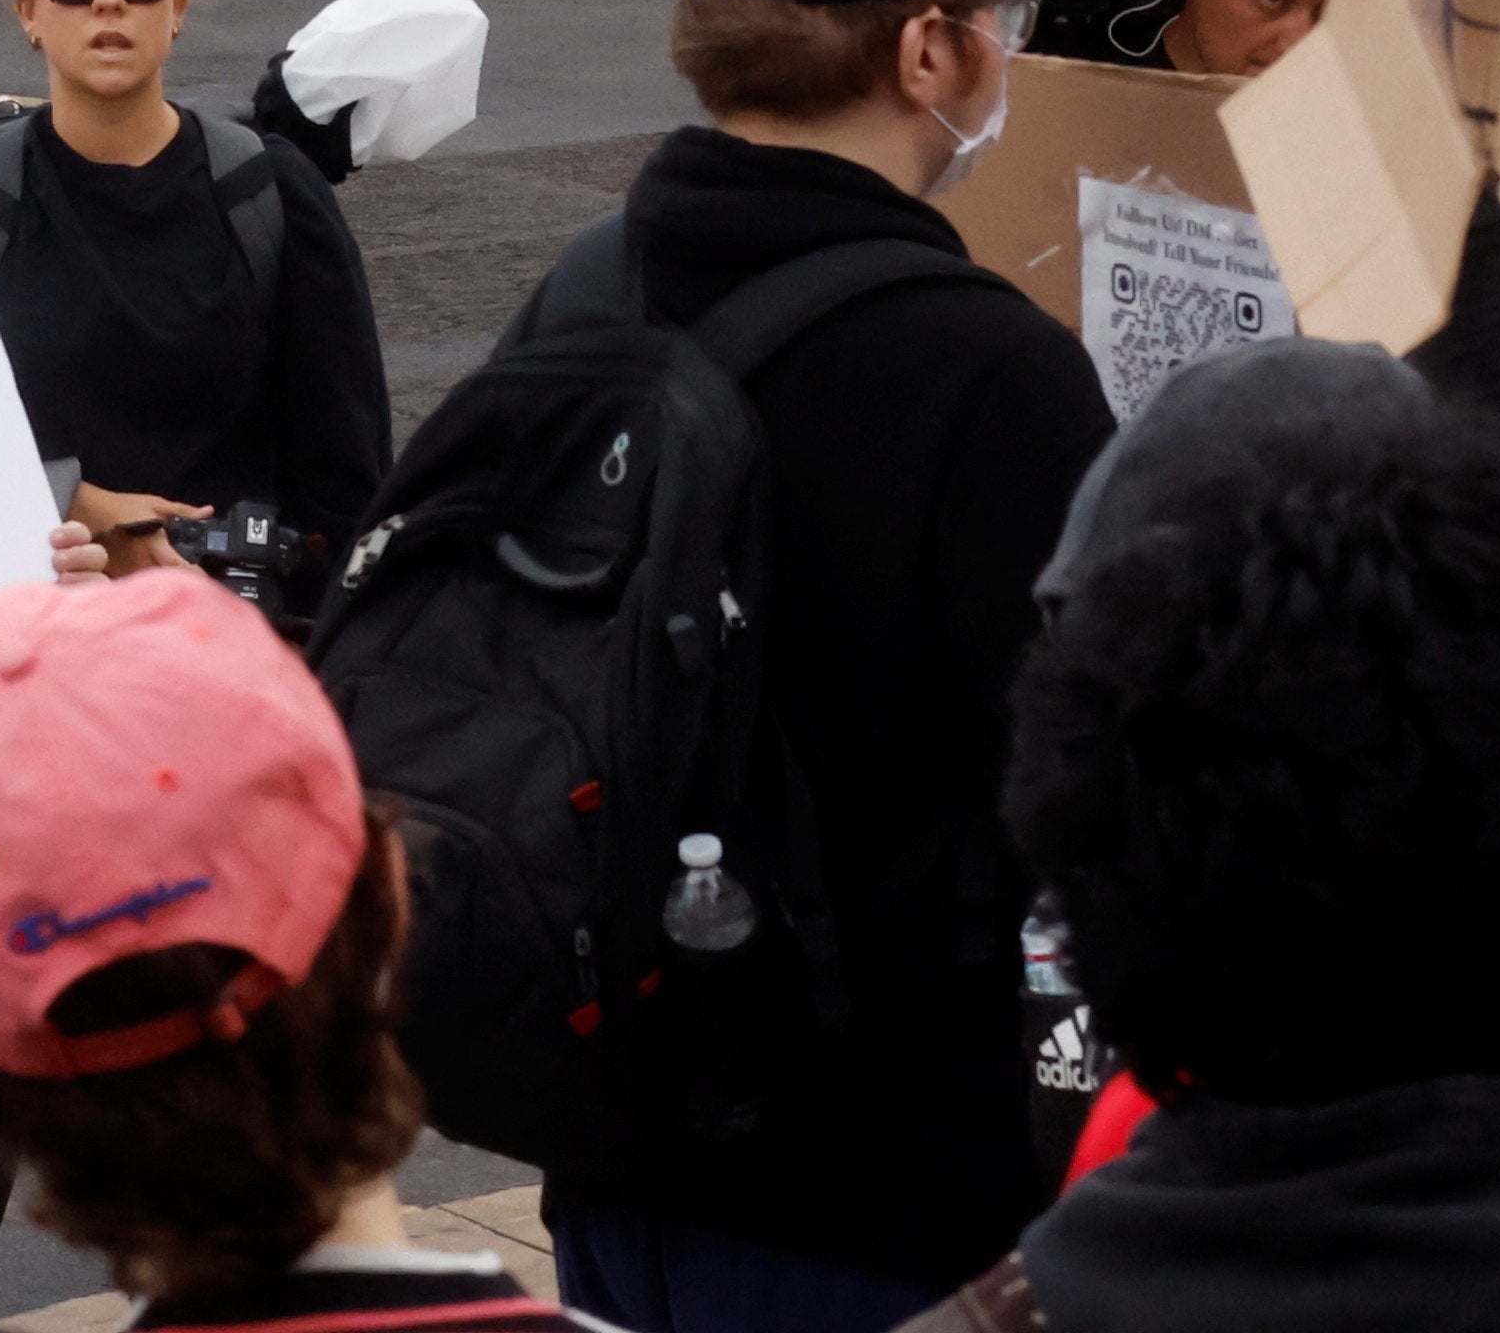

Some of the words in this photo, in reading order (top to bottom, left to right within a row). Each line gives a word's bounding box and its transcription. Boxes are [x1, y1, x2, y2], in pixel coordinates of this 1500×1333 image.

[1117, 203, 1157, 228] Follow
[1164, 242, 1185, 262] Tell
[1190, 247, 1222, 269] Your
